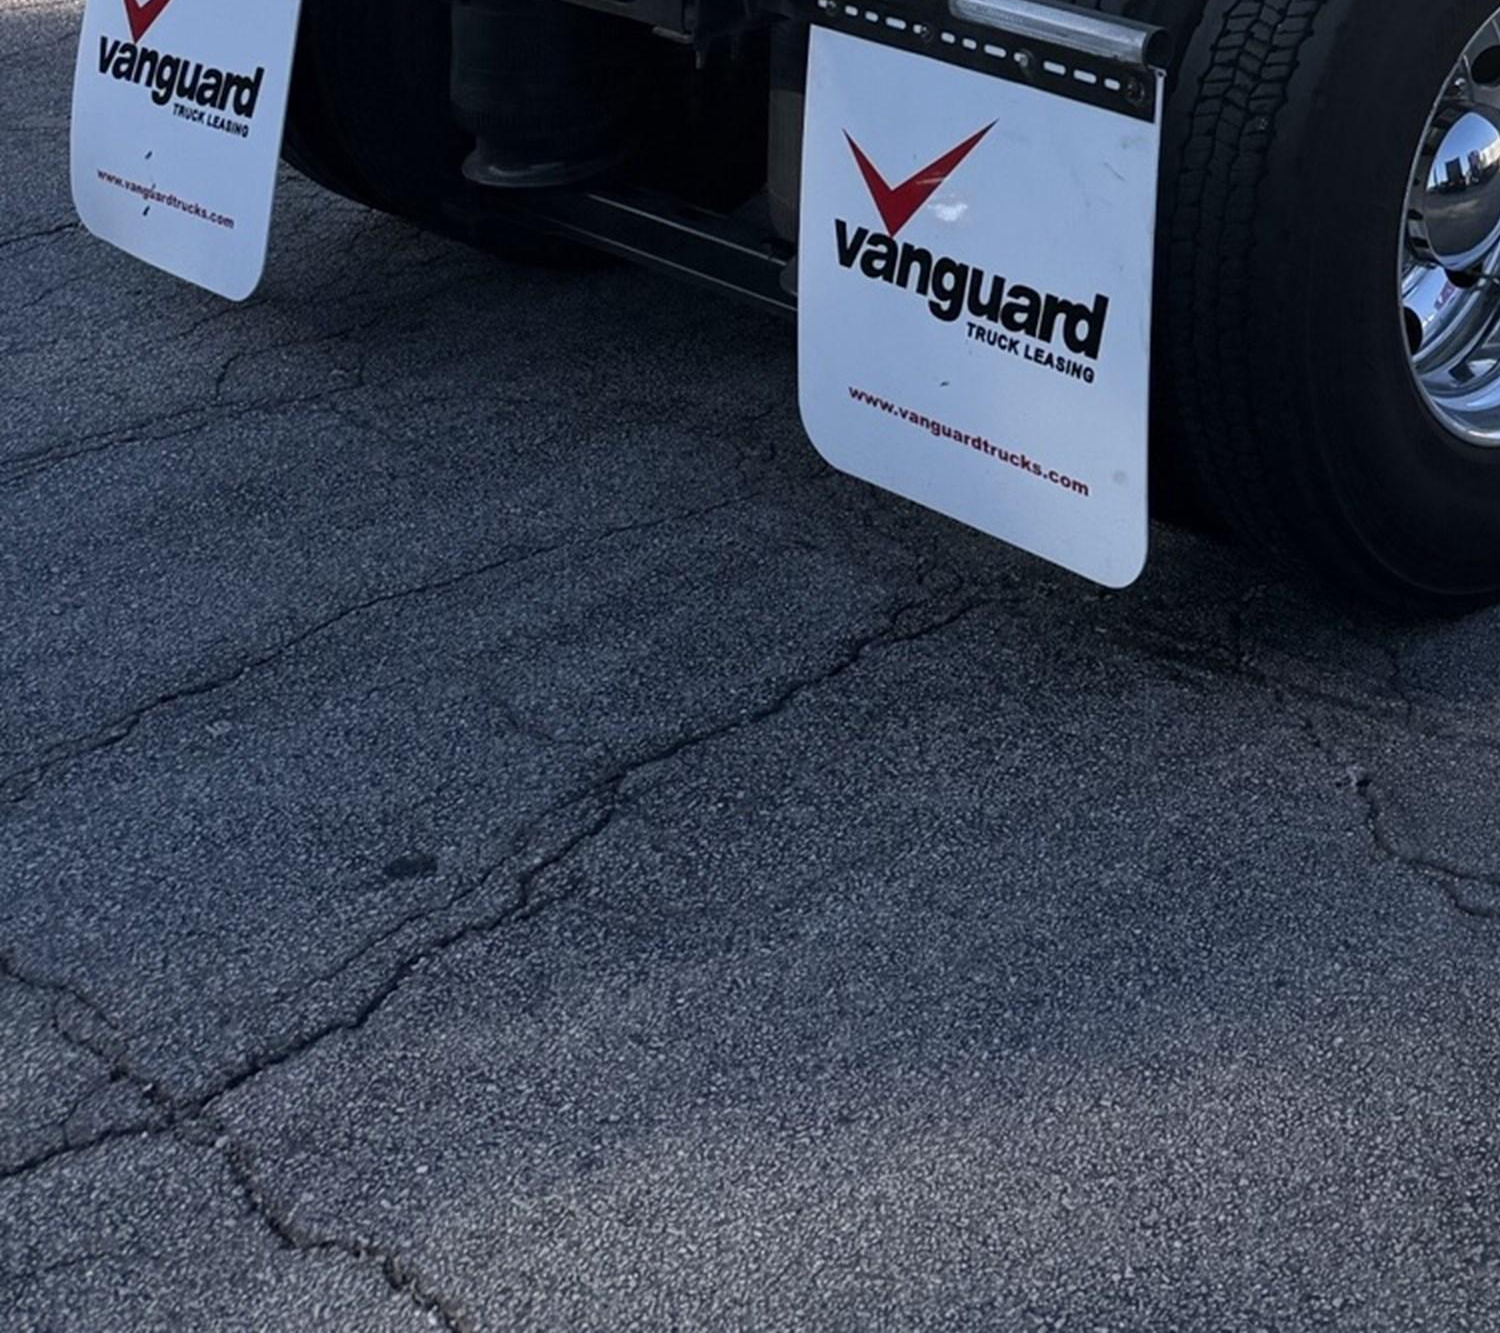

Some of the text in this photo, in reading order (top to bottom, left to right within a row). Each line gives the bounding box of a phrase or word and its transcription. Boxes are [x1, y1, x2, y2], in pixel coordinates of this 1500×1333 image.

[98, 35, 265, 119] vanguard
[172, 102, 249, 138] TRUCK LEASING
[97, 169, 235, 229] www.vanguardtrucks.com
[834, 218, 1109, 360] vanguard
[966, 321, 1095, 384] TRUCK LEASING
[848, 386, 1090, 497] www.vanguardtrucks.com
